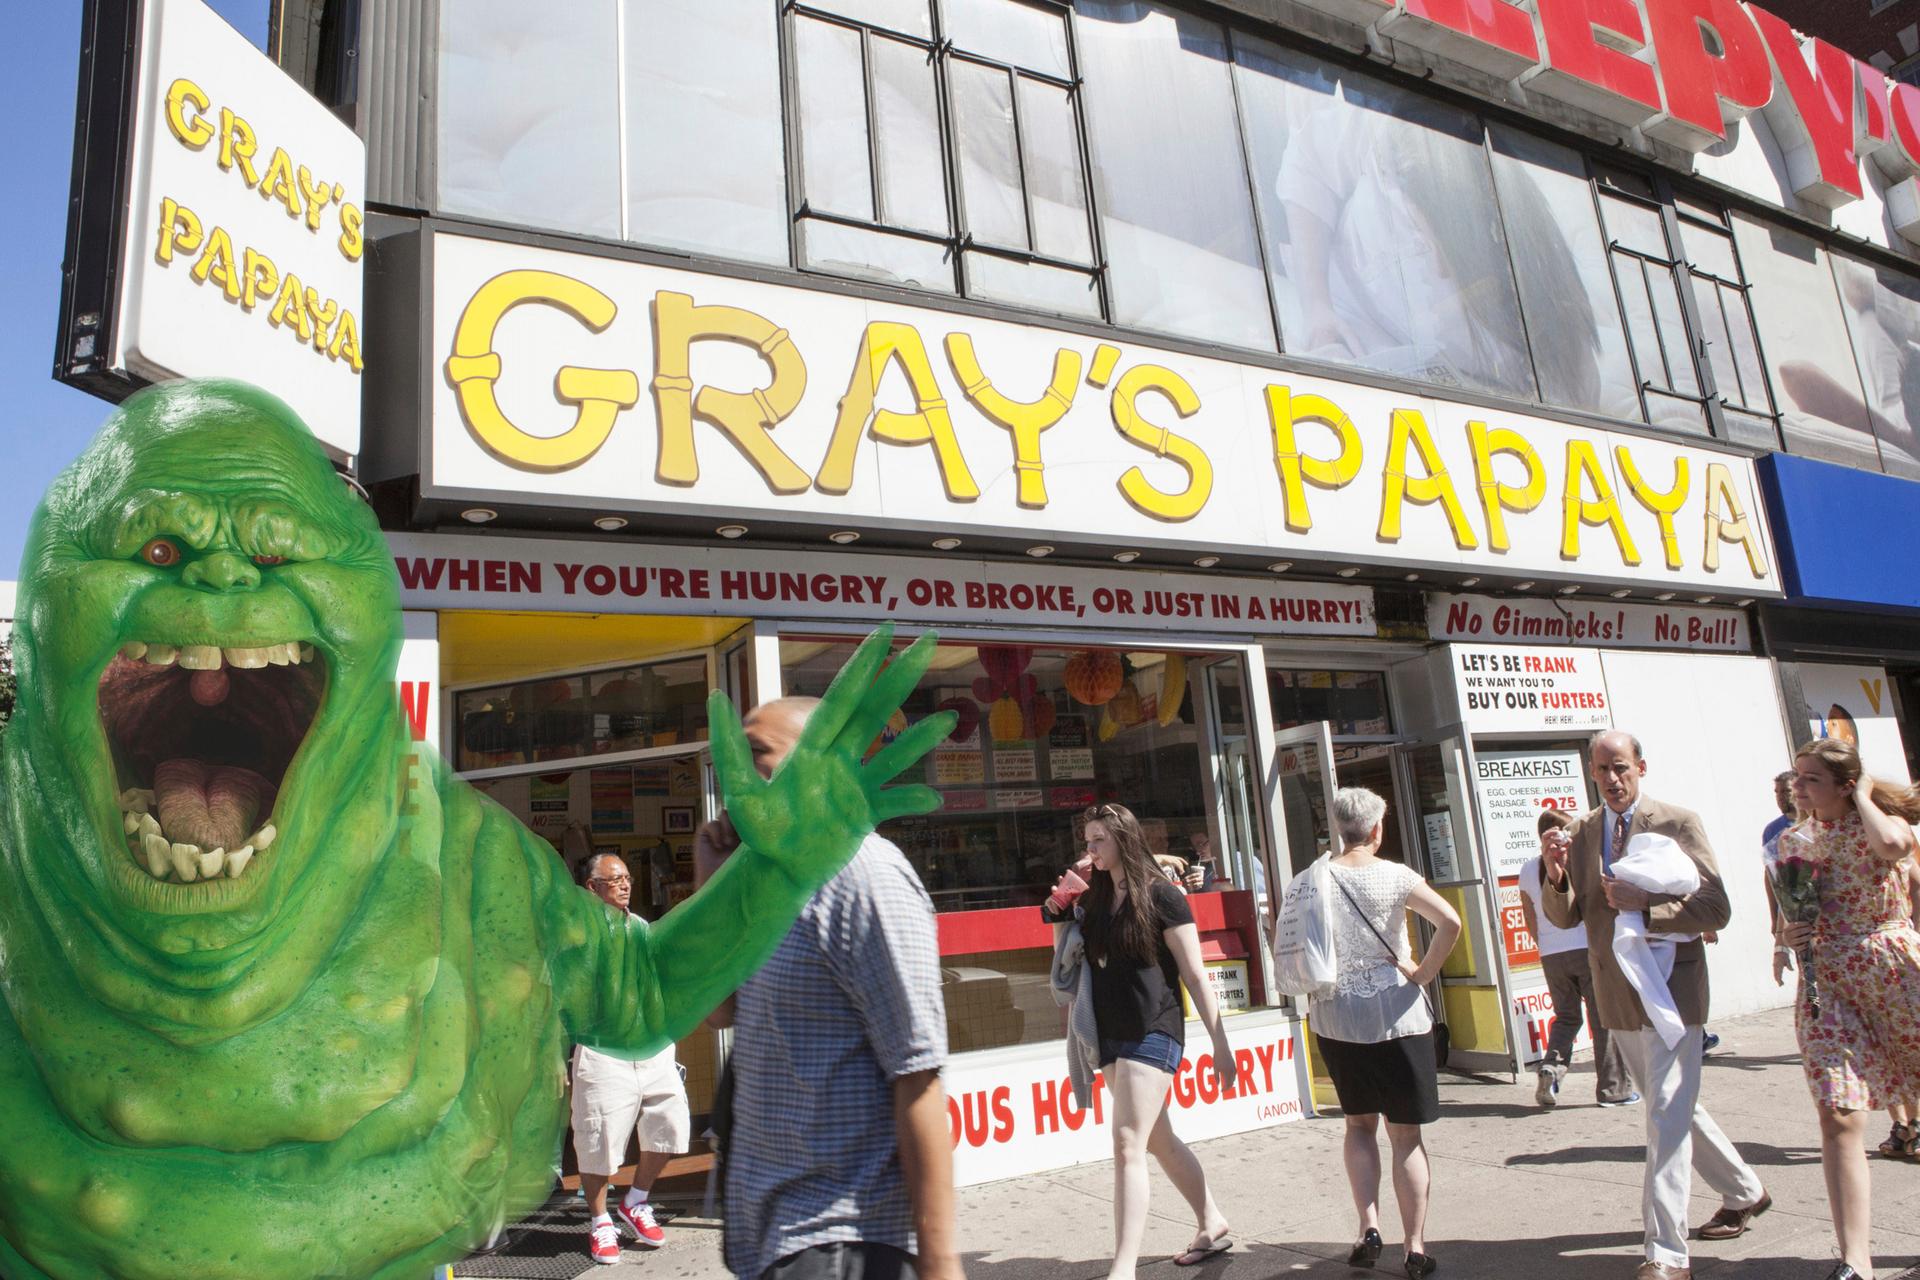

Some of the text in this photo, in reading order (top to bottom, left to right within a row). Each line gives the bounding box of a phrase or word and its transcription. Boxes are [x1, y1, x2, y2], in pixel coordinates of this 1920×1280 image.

[165, 78, 363, 261] GRAY'S
[156, 196, 364, 372] PAPAYA
[444, 269, 1768, 579] GRAY'S PAPAYA
[394, 557, 1362, 624] WHEN YOU'RE HUNGRY, OR BROKE, OR JUST IN A HURRY!
[1446, 601, 1738, 644] No Gimmicks! No Bull!
[1461, 653, 1577, 673] LET'S BE FRANK
[1466, 677, 1554, 688] WE WANT YOU TO
[1467, 692, 1605, 709] BUY OUR FURTERS
[1477, 760, 1571, 778] BREAKFAST
[1544, 786, 1561, 794] HAM
[1563, 785, 1575, 793] OR
[1489, 799, 1527, 808] SAUSAGE
[1491, 810, 1534, 820] ON A ROLL
[1509, 831, 1530, 839] WITH
[1505, 840, 1537, 850] COFFEE
[1217, 970, 1238, 981] FRANK
[1220, 989, 1245, 1000] FURTERS
[946, 1086, 1015, 1151] OUS
